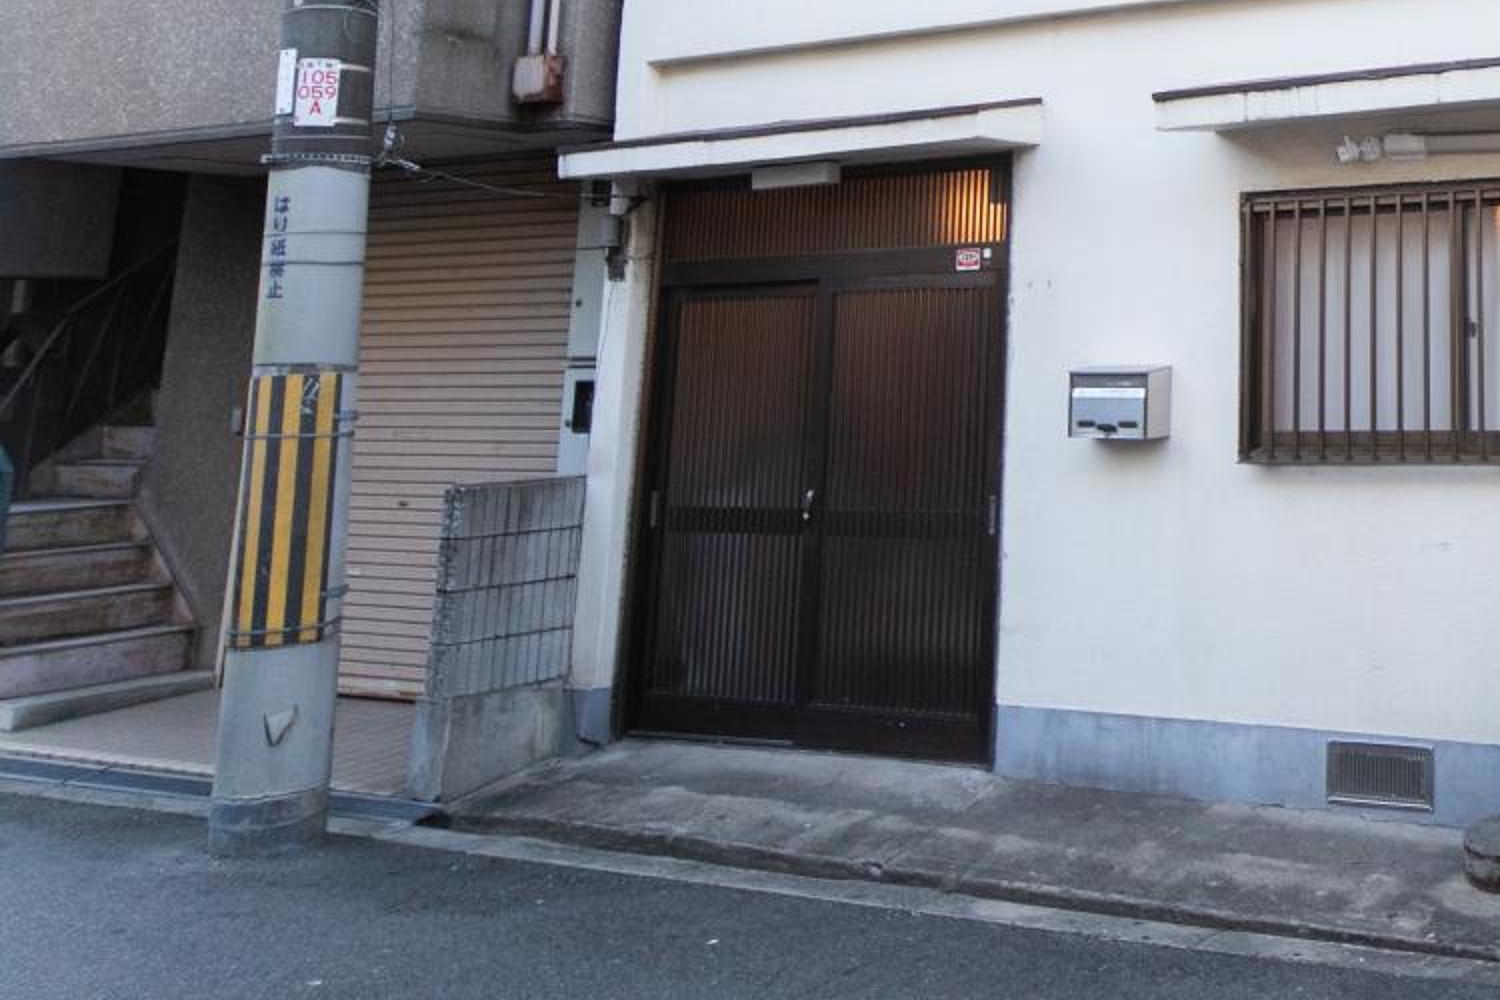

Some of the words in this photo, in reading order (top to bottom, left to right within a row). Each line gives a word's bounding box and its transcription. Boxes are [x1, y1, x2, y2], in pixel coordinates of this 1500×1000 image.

[302, 69, 338, 86] 105
[298, 85, 337, 100] 059
[309, 100, 322, 116] A
[267, 196, 291, 300] はり紙禁止
